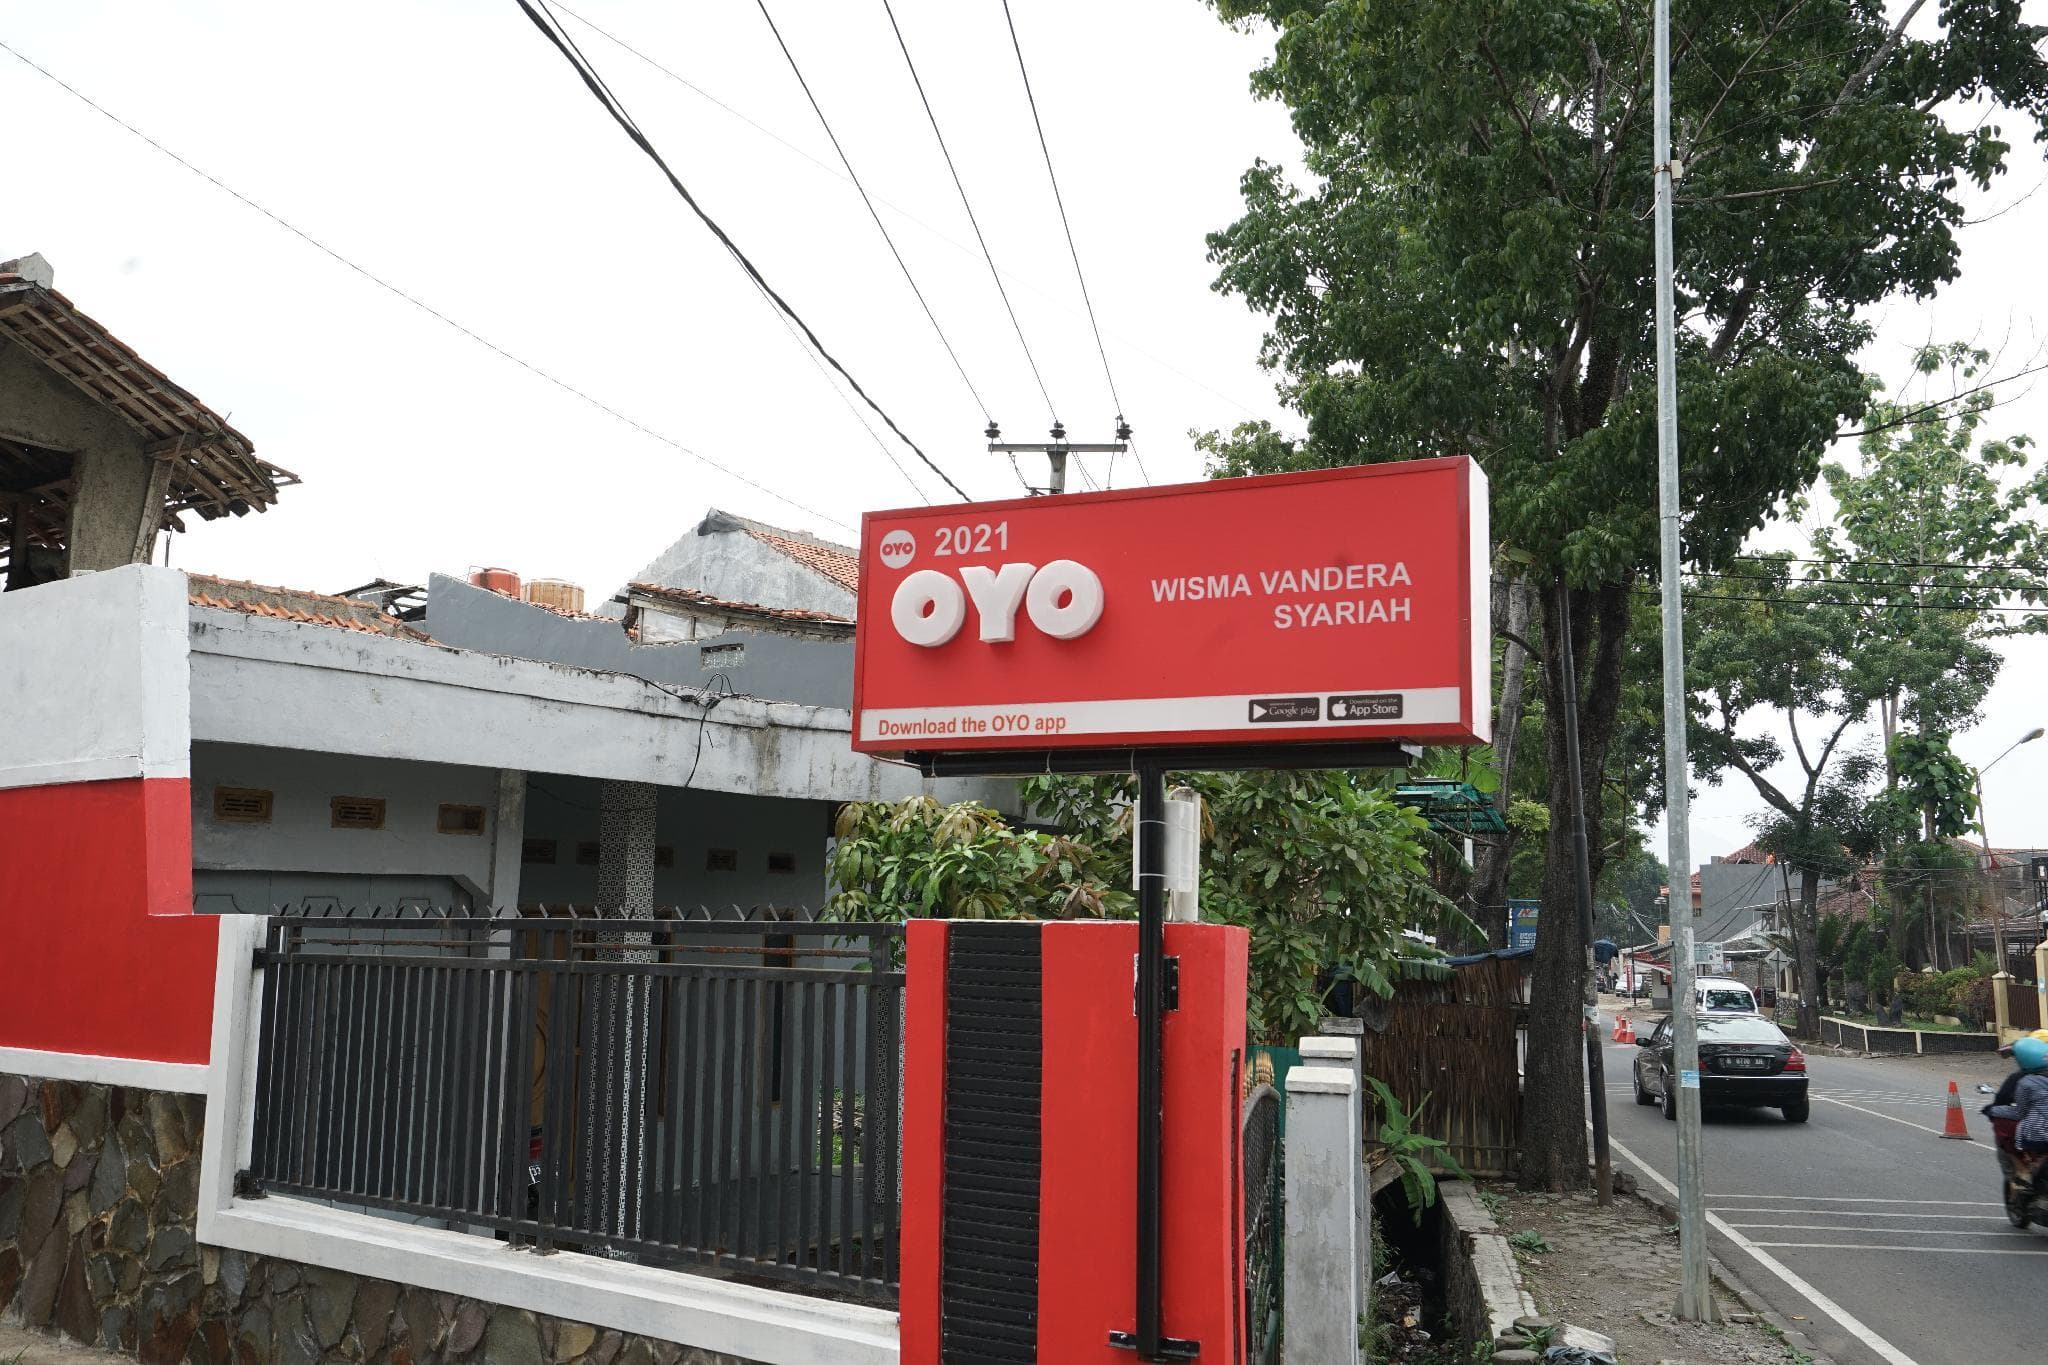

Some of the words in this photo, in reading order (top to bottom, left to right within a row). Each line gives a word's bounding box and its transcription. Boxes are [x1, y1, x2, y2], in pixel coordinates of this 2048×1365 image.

[881, 541, 914, 555] OYO
[934, 521, 1008, 557] 2021
[1150, 573, 1253, 603] WISMA
[1259, 561, 1412, 595] VANDERA
[890, 559, 1105, 648] OYO
[1273, 597, 1411, 629] SYARIAH
[1269, 705, 1299, 718] Google
[1300, 704, 1317, 716] play
[1350, 704, 1371, 717] App
[1372, 702, 1398, 715] Store
[878, 717, 957, 736] Download
[961, 716, 987, 733] the
[992, 714, 1030, 732] OYO
[1034, 715, 1066, 734] app
